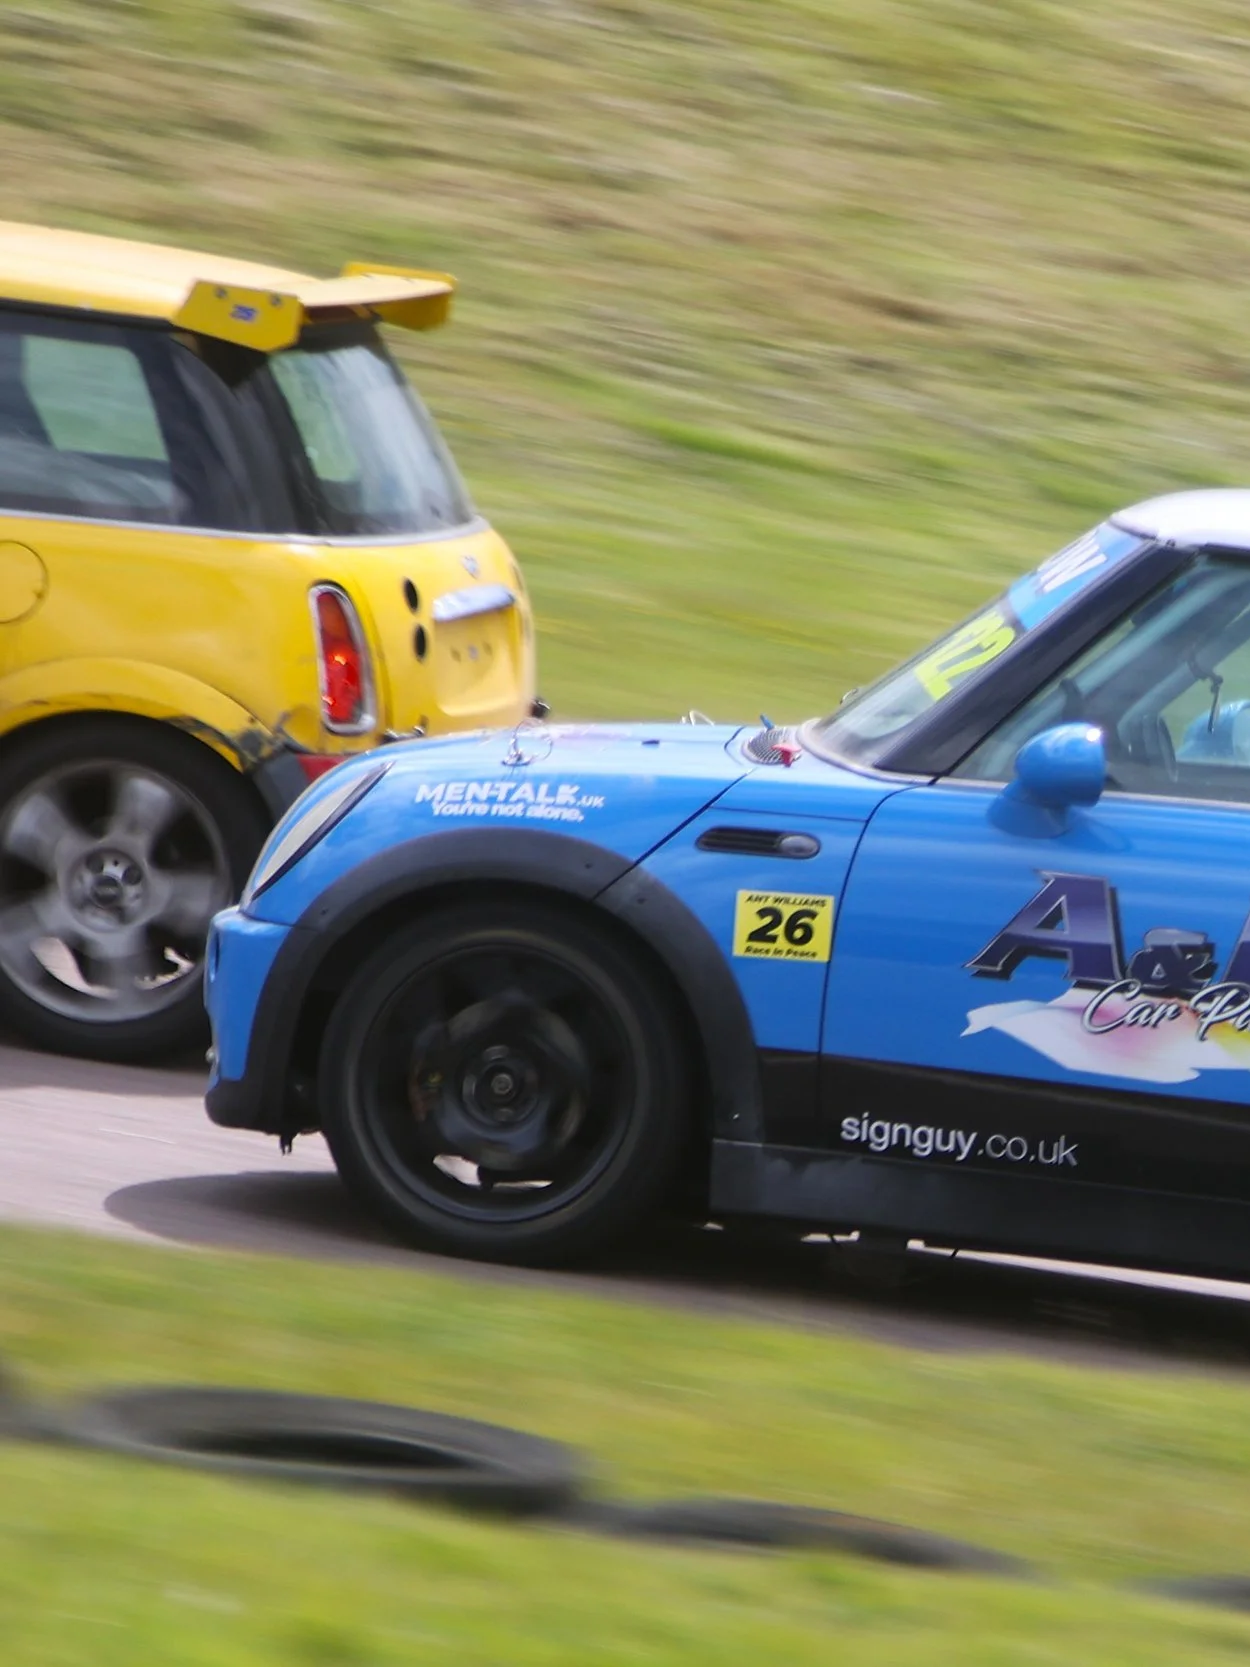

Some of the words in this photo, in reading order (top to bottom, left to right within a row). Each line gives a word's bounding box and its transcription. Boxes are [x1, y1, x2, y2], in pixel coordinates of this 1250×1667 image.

[490, 803, 525, 818] not
[772, 895, 827, 908] WILLIAMS
[746, 906, 819, 947] 26
[744, 945, 770, 956] Race
[772, 947, 783, 957] in
[784, 948, 818, 959] Peace
[1081, 977, 1182, 1035] Car
[840, 1111, 1079, 1167] signguy.co.uk
